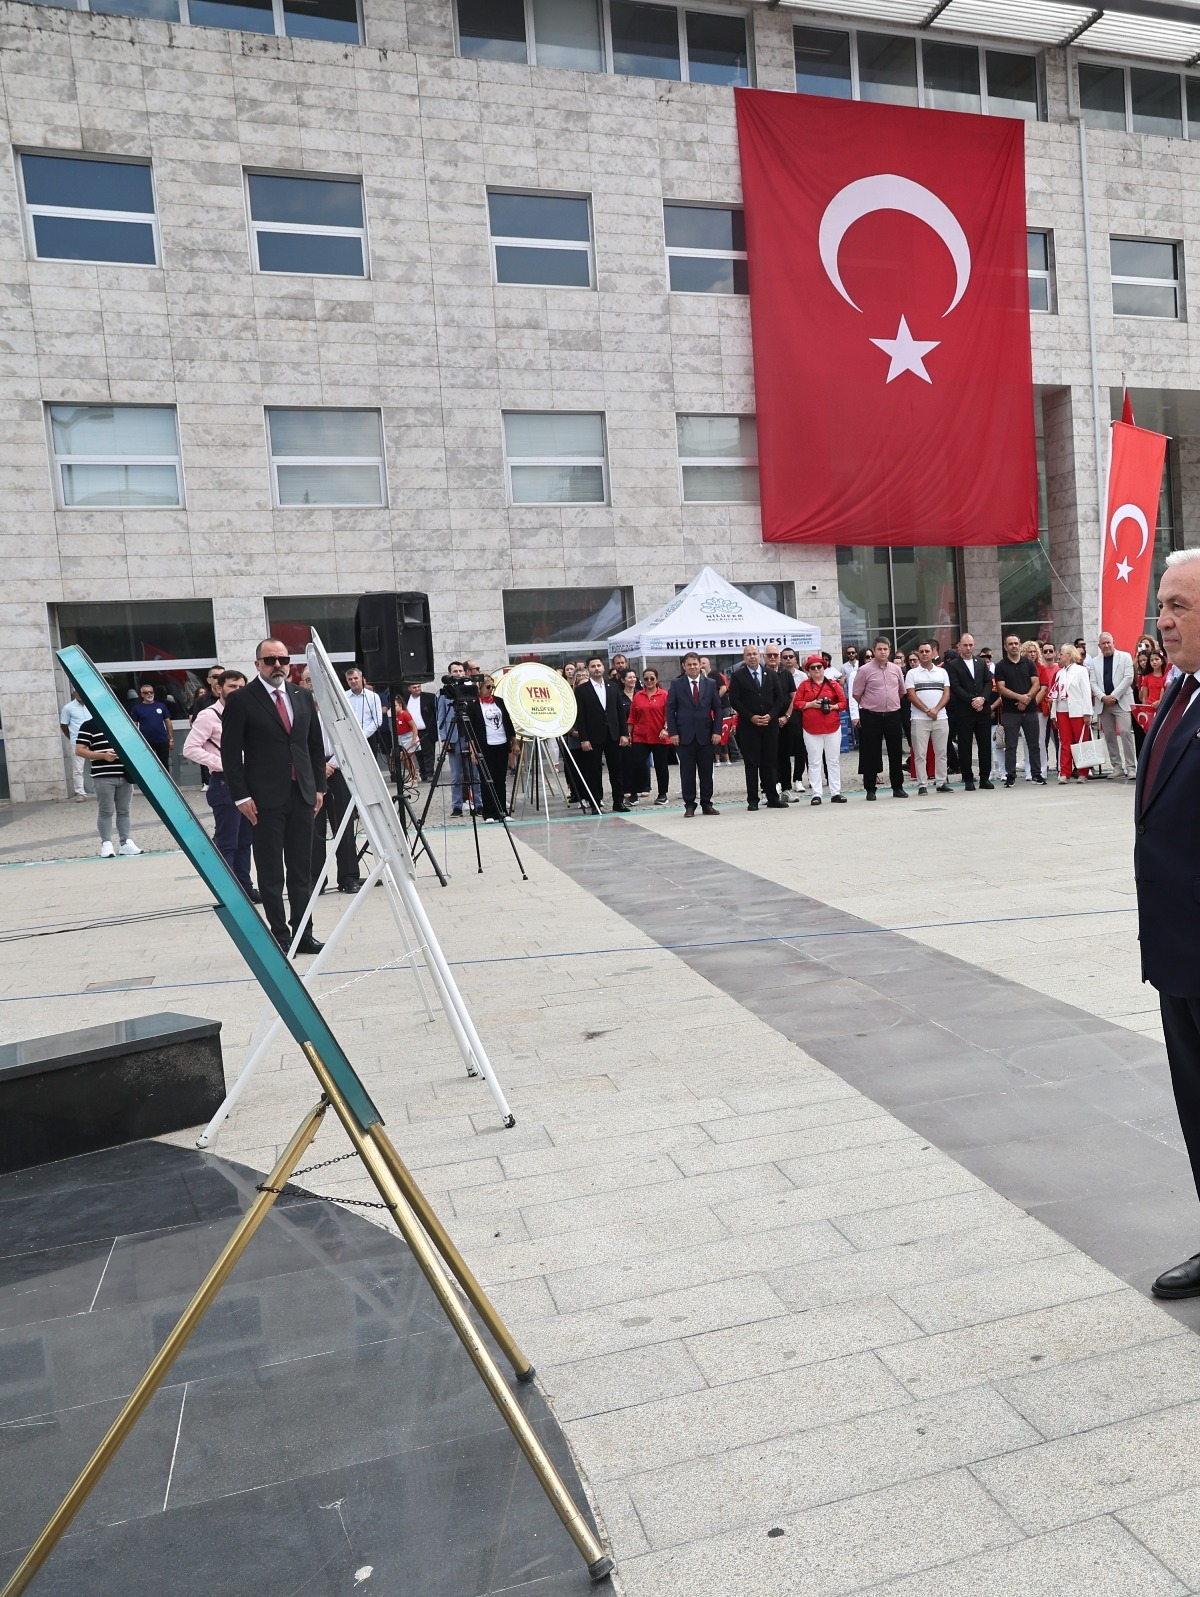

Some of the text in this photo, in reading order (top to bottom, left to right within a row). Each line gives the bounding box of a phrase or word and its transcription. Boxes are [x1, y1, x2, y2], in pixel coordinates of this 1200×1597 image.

[666, 634, 787, 650] NİLÜFER BELEDİYESİ
[526, 686, 551, 699] YENİ
